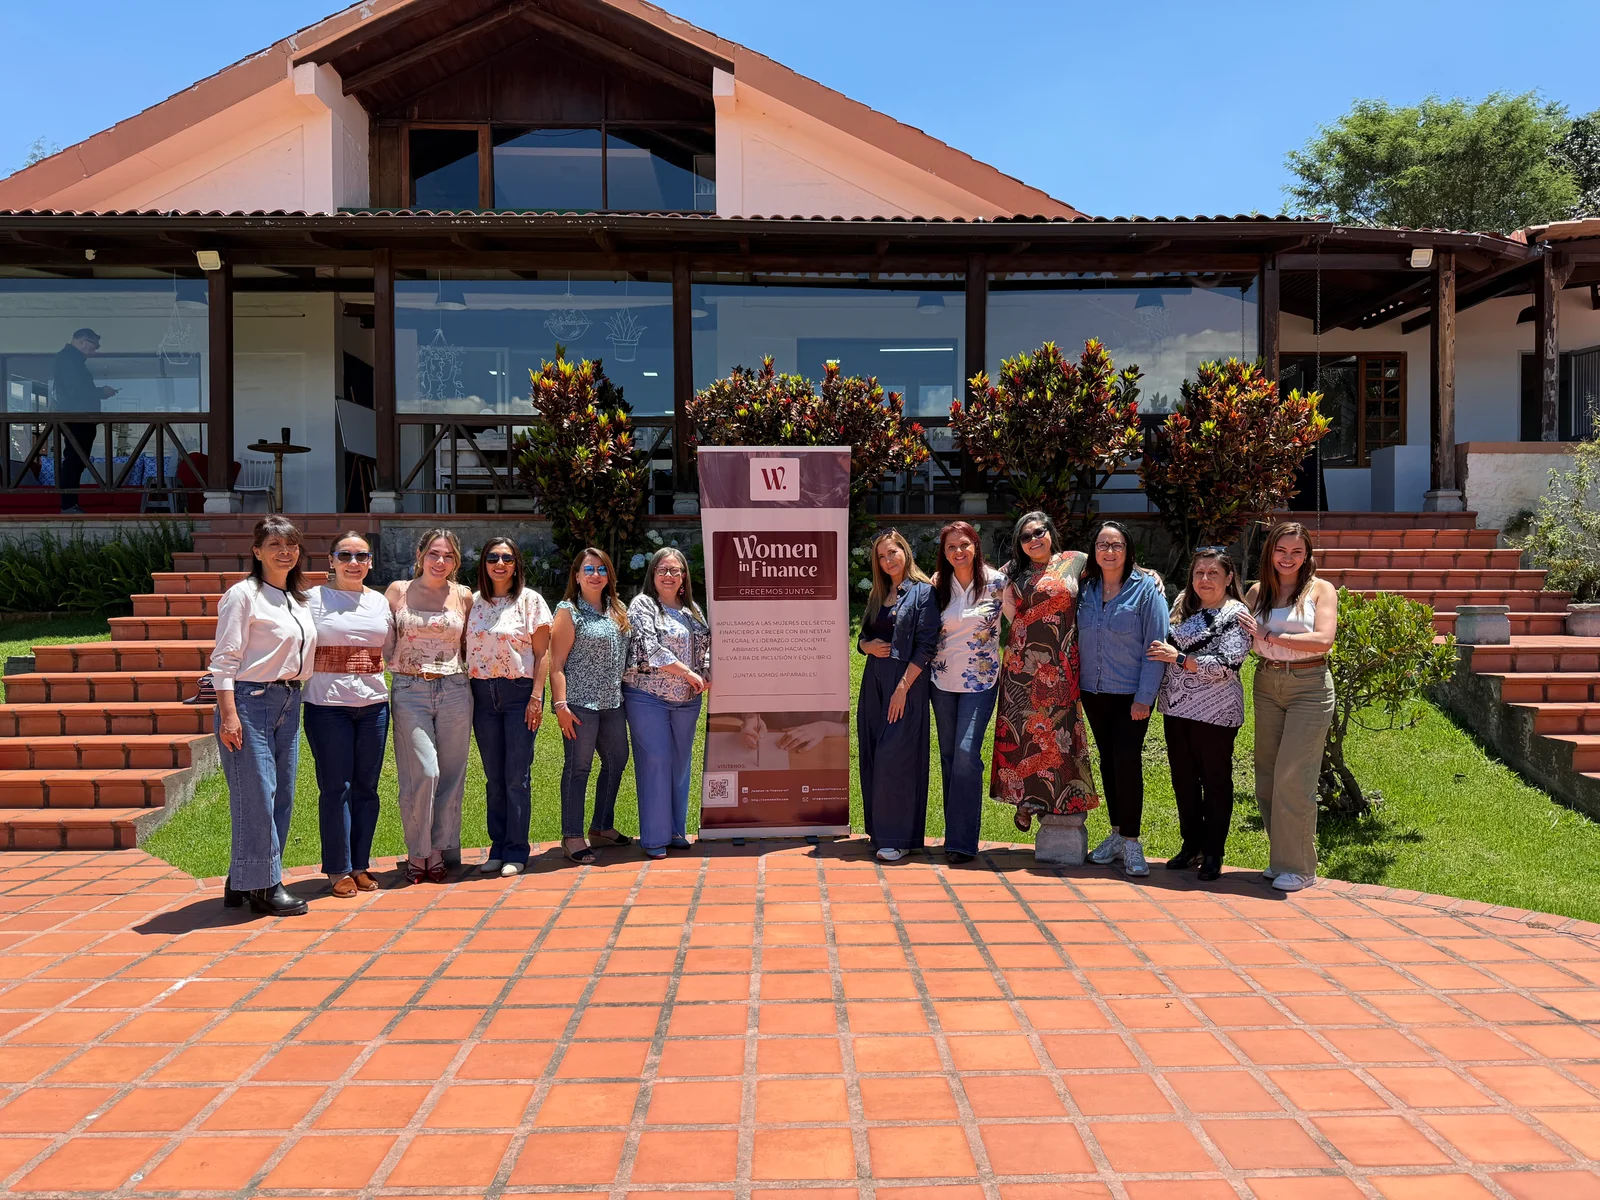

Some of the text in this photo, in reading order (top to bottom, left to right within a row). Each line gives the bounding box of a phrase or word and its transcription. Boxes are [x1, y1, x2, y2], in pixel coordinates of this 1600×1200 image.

[761, 466, 787, 490] W.
[732, 534, 818, 559] Women
[739, 560, 818, 578] in Finance
[739, 588, 783, 596] CRECEMOS
